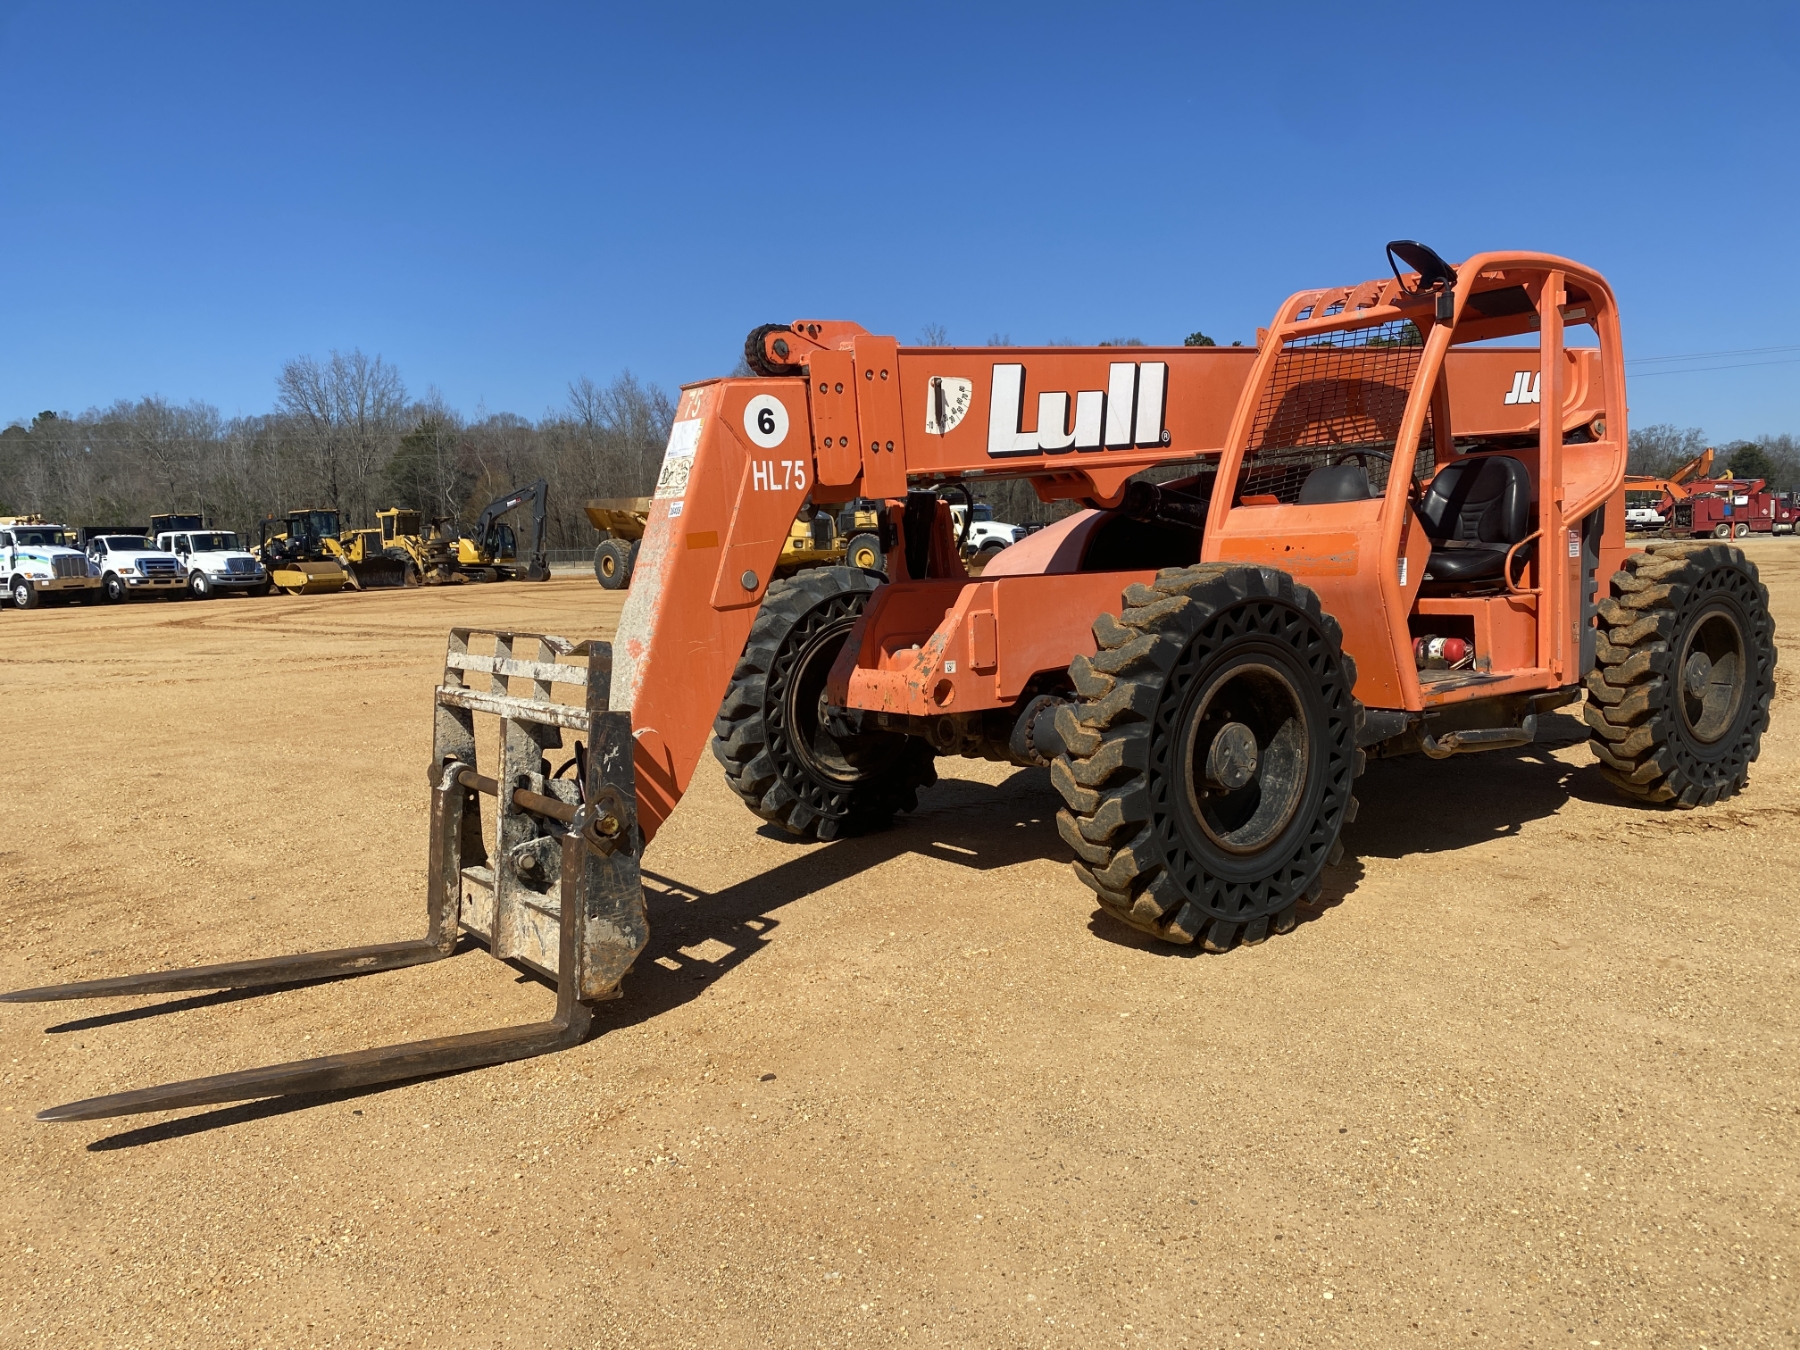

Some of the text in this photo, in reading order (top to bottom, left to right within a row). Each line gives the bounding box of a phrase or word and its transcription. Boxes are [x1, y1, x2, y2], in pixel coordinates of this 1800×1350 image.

[684, 389, 704, 418] 75
[757, 408, 775, 434] 6
[752, 460, 806, 491] HL75
